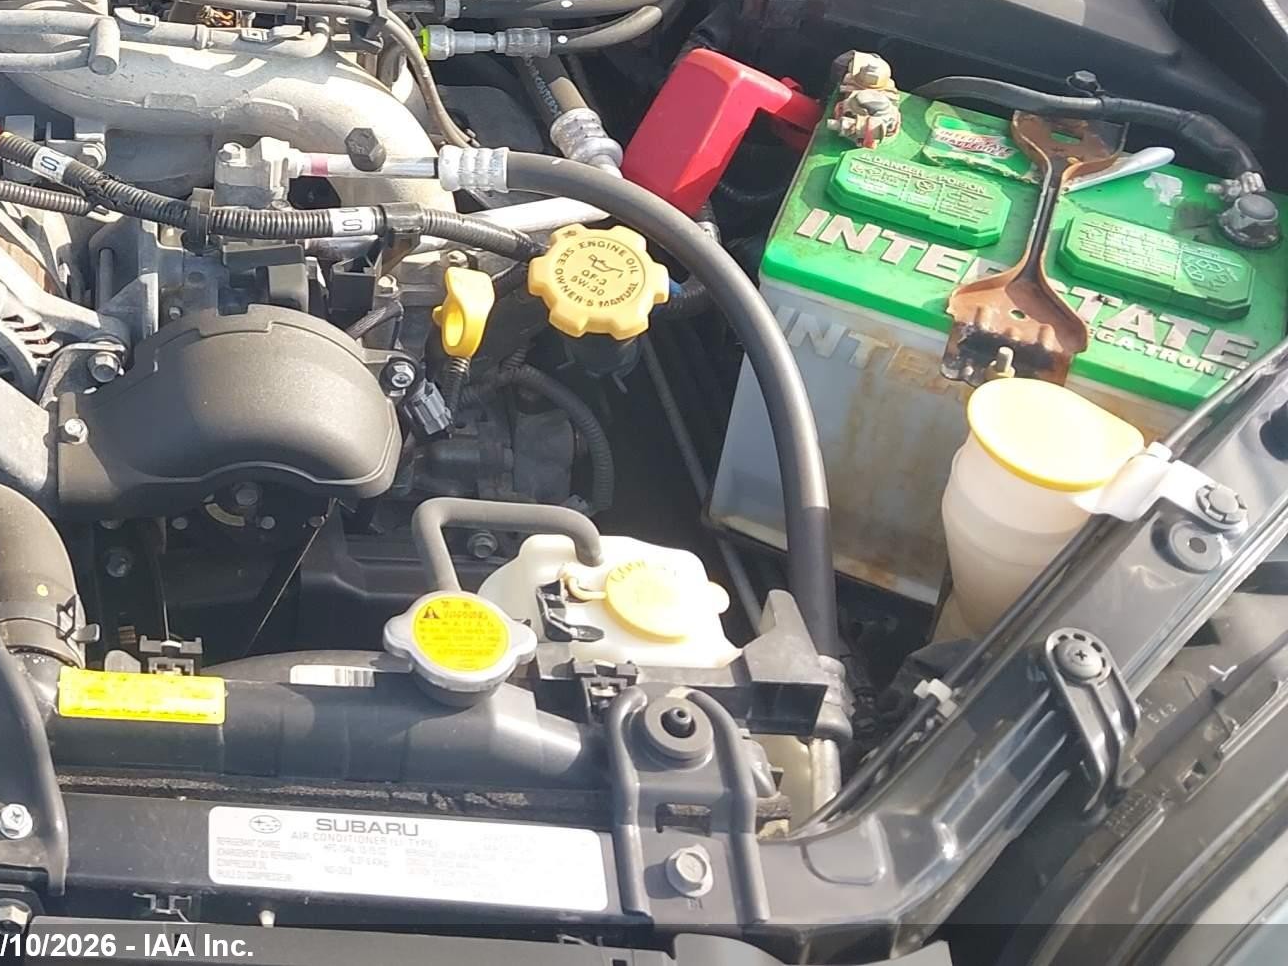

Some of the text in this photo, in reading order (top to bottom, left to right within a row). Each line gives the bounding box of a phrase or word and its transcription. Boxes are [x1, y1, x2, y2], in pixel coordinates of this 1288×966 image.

[40, 155, 60, 172] S
[342, 218, 363, 232] S
[578, 240, 640, 275] ENGINE OIL
[556, 247, 575, 265] SEE
[599, 281, 640, 308] MANUAL
[316, 818, 418, 837] SUBARU
